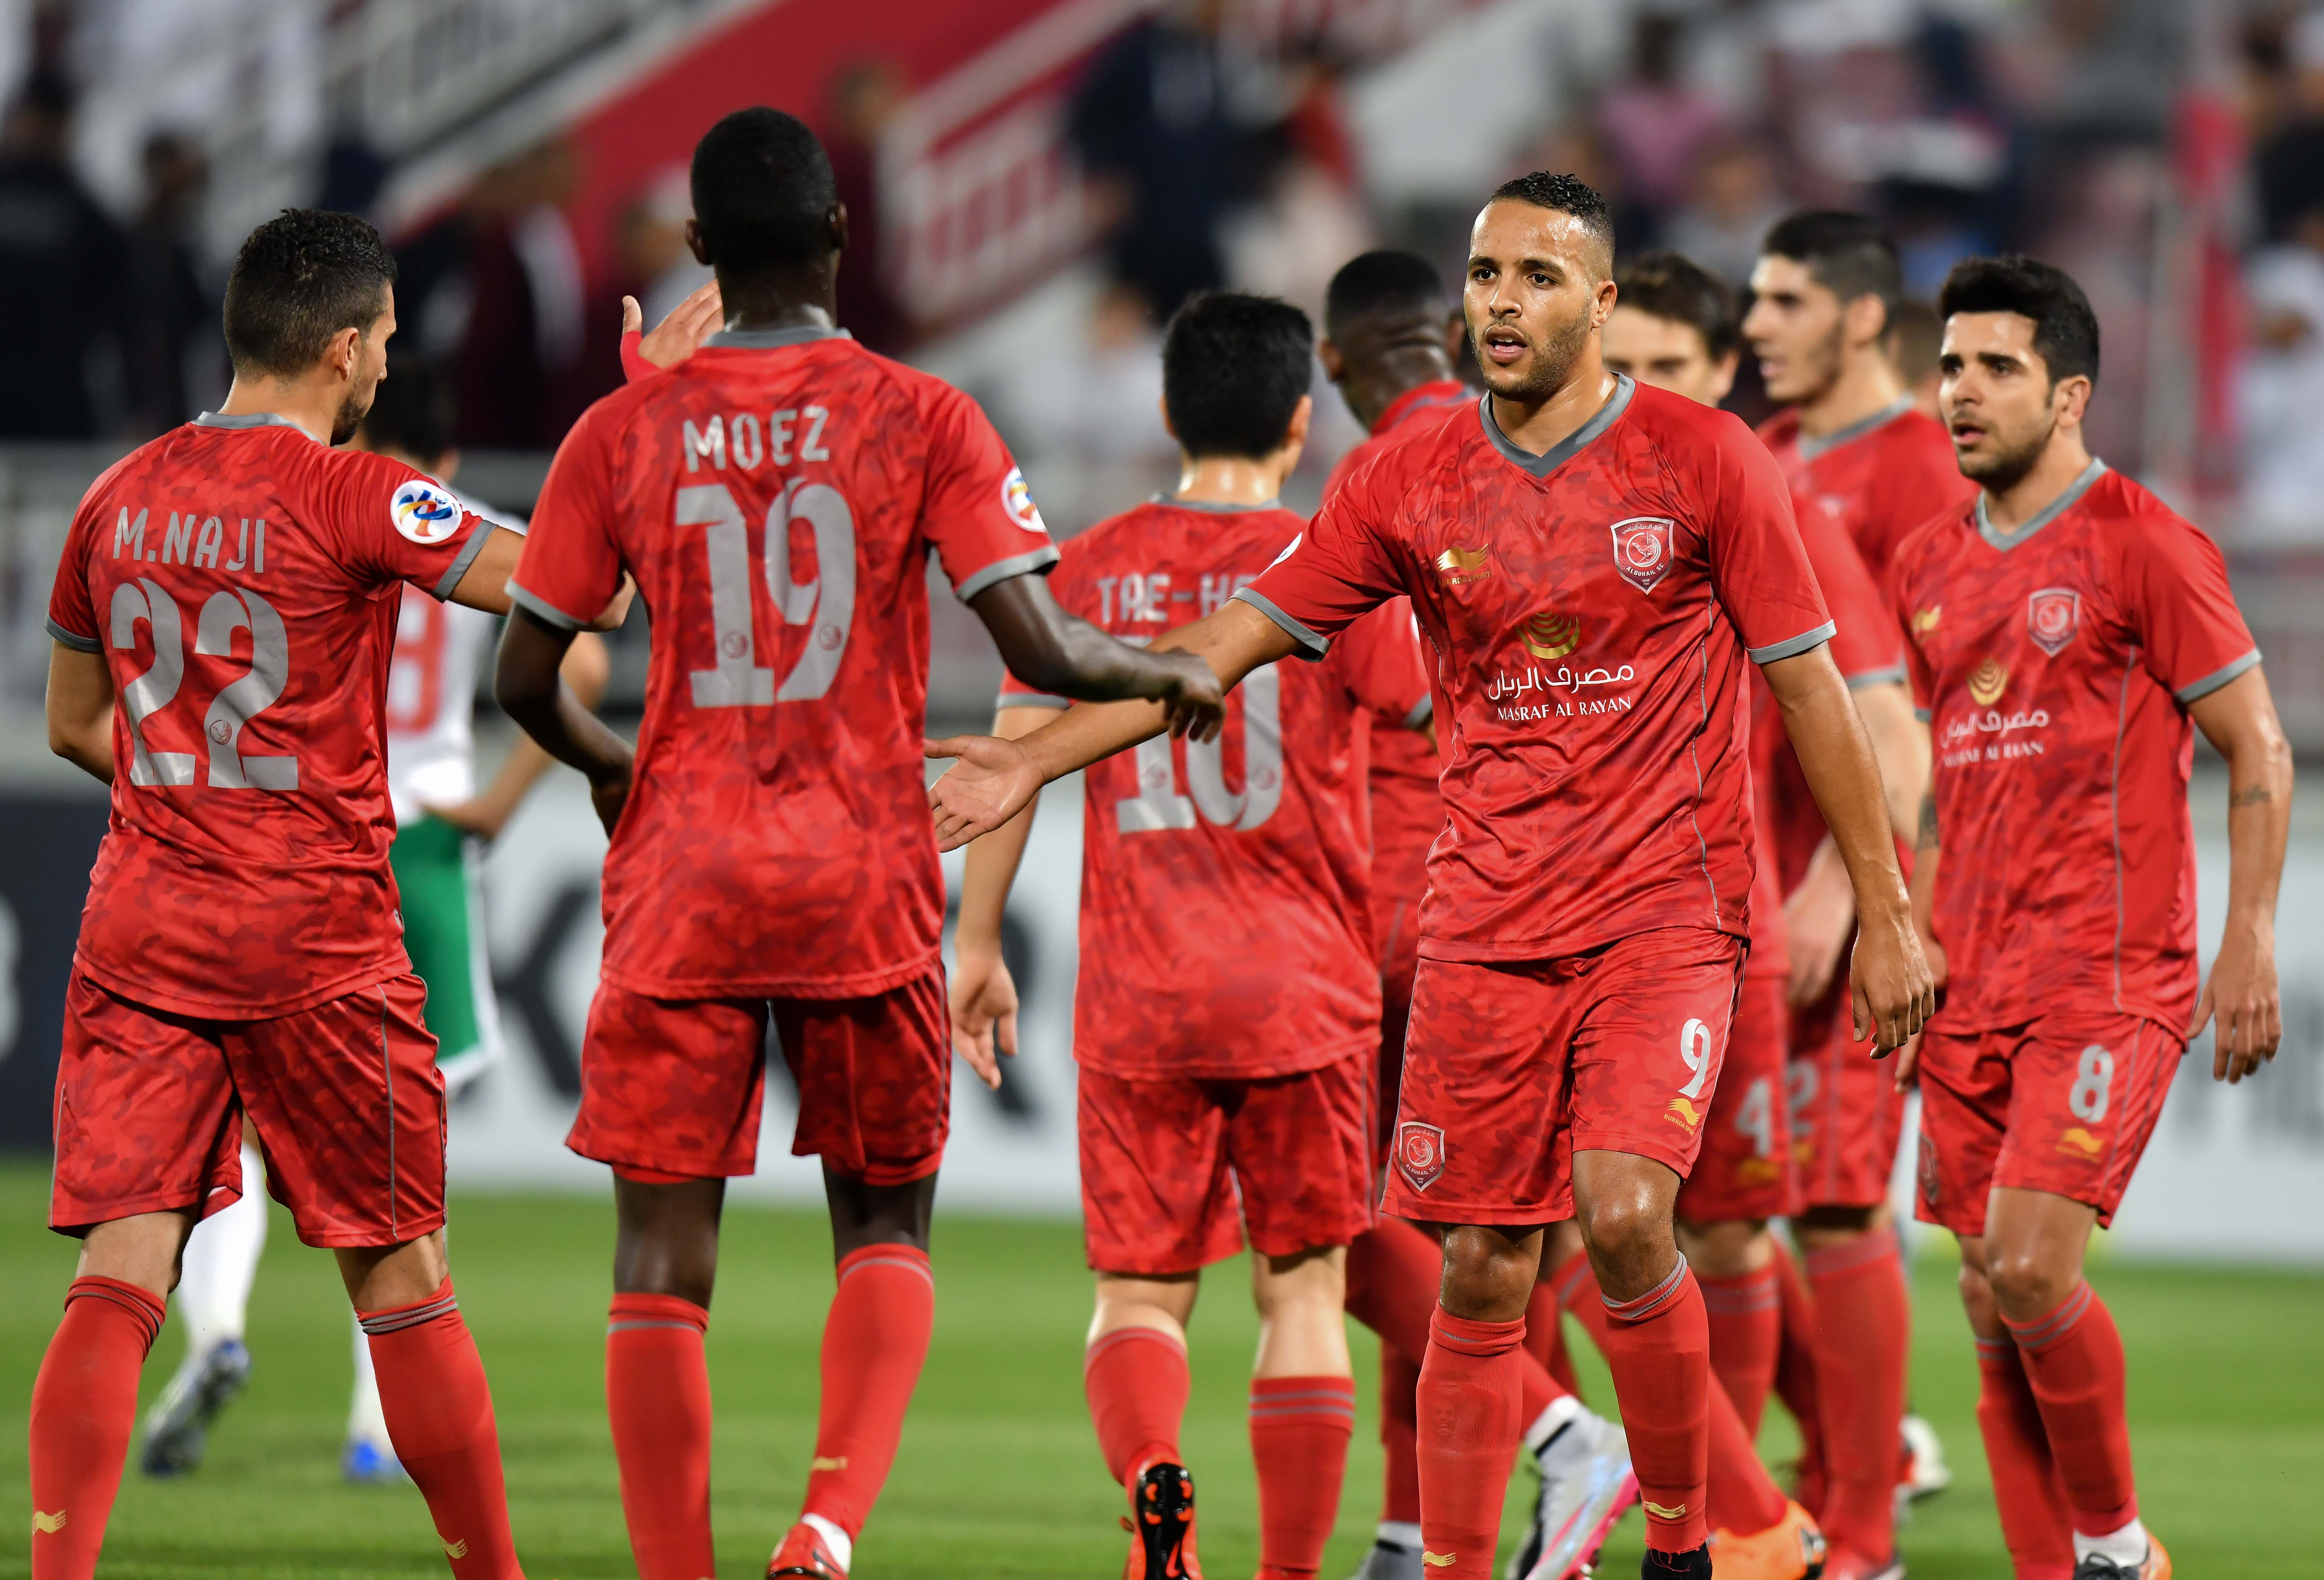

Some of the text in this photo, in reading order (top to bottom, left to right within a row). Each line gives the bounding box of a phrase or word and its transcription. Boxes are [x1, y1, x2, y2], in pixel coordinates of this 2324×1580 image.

[684, 406, 830, 473] MOEZ
[113, 506, 265, 573] M.NAJI
[676, 477, 857, 709] 19
[110, 577, 299, 790] 22
[1488, 664, 1634, 700] مصرف الريان
[1497, 696, 1632, 721] MASRAF AL RAYAN
[1113, 635, 1285, 834] 10
[1678, 1018, 1711, 1099] 9
[2069, 1044, 2115, 1123] 8
[1664, 1113, 1685, 1129] BURRDA
[1733, 1076, 1772, 1157] 4
